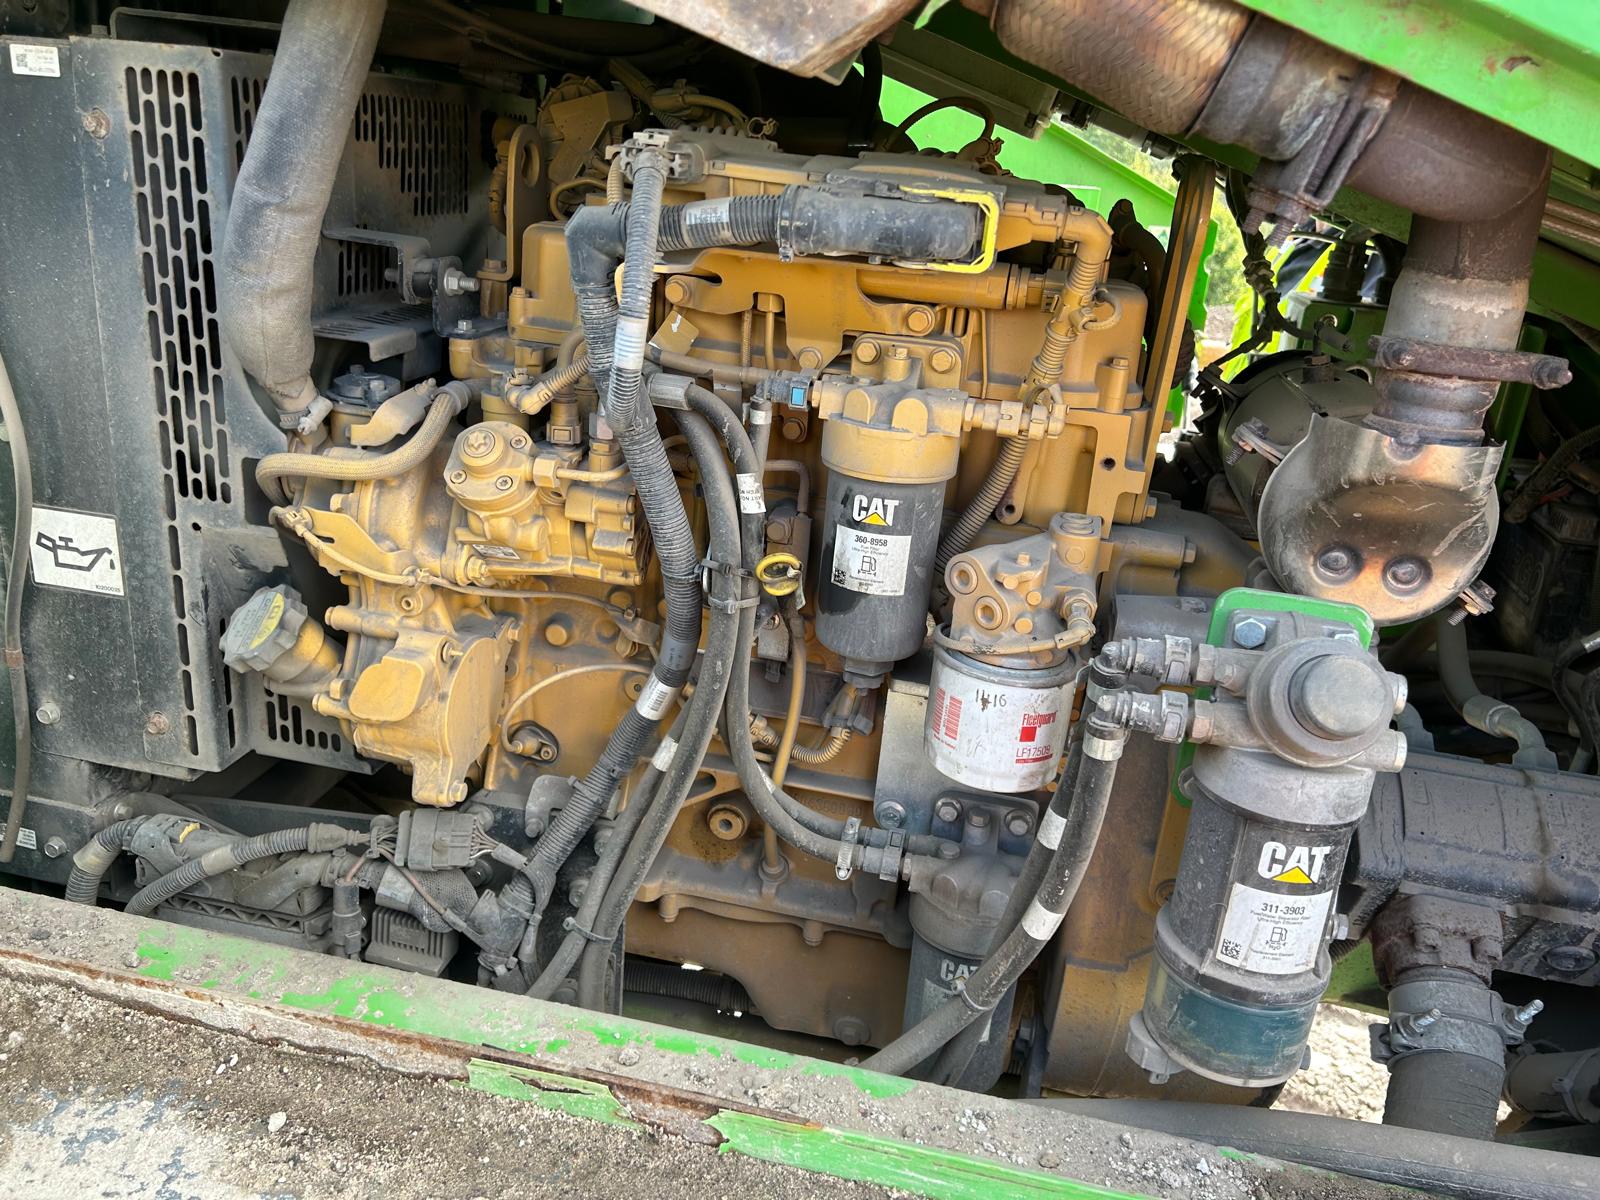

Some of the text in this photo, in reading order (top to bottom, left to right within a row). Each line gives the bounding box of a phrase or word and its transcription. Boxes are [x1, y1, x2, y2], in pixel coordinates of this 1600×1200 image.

[853, 494, 900, 527] CAT
[854, 534, 888, 547] 360-8958
[1021, 711, 1058, 728] Fleetguard
[1015, 744, 1051, 758] LF17509
[1257, 841, 1331, 884] CAT
[1261, 902, 1306, 915] 311-3903
